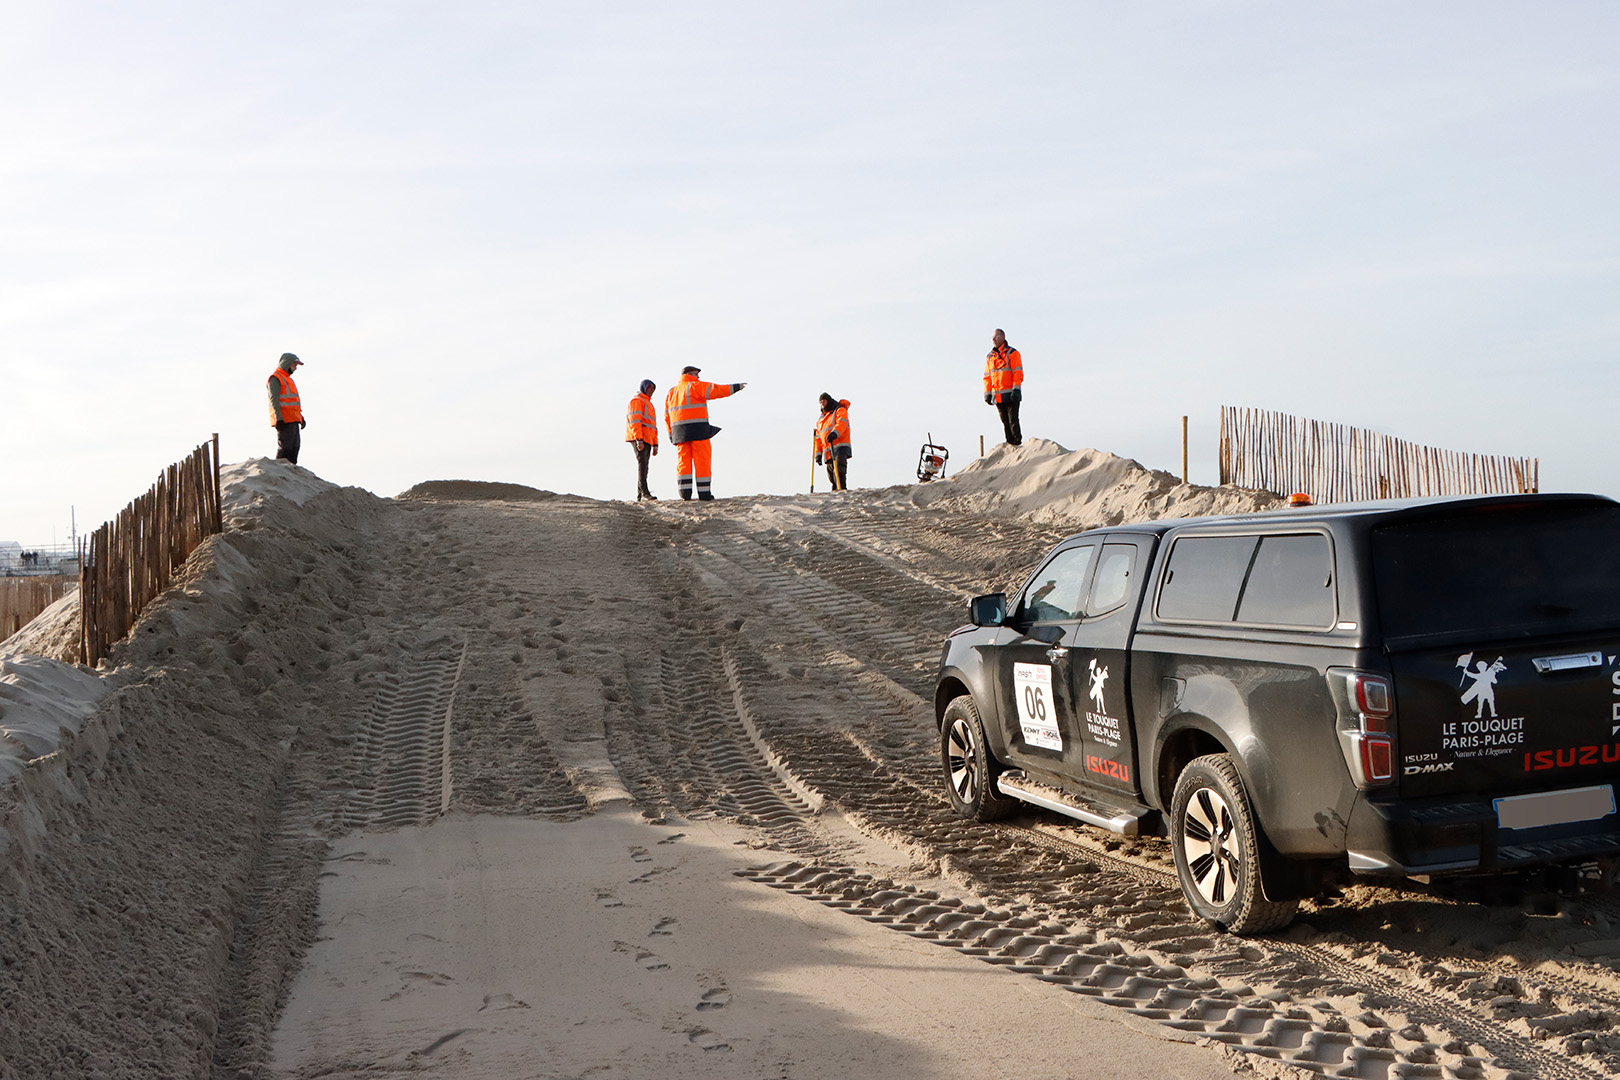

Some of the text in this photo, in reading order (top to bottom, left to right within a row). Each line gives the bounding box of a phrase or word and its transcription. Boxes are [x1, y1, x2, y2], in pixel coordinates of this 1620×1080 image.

[1025, 685, 1046, 722] 06
[1086, 711, 1119, 730] LE TOUQUET
[1442, 717, 1525, 736] LE TOUQUET
[1087, 722, 1122, 741] PARIS-PLAGE
[1442, 731, 1524, 750] PARIS-PLAGE
[1404, 752, 1439, 763] ISUZU
[1453, 746, 1514, 758] Nature & Elegance
[1524, 742, 1620, 772] ISUZU
[1086, 754, 1129, 782] ISUZU
[1403, 762, 1455, 775] D-MAX
